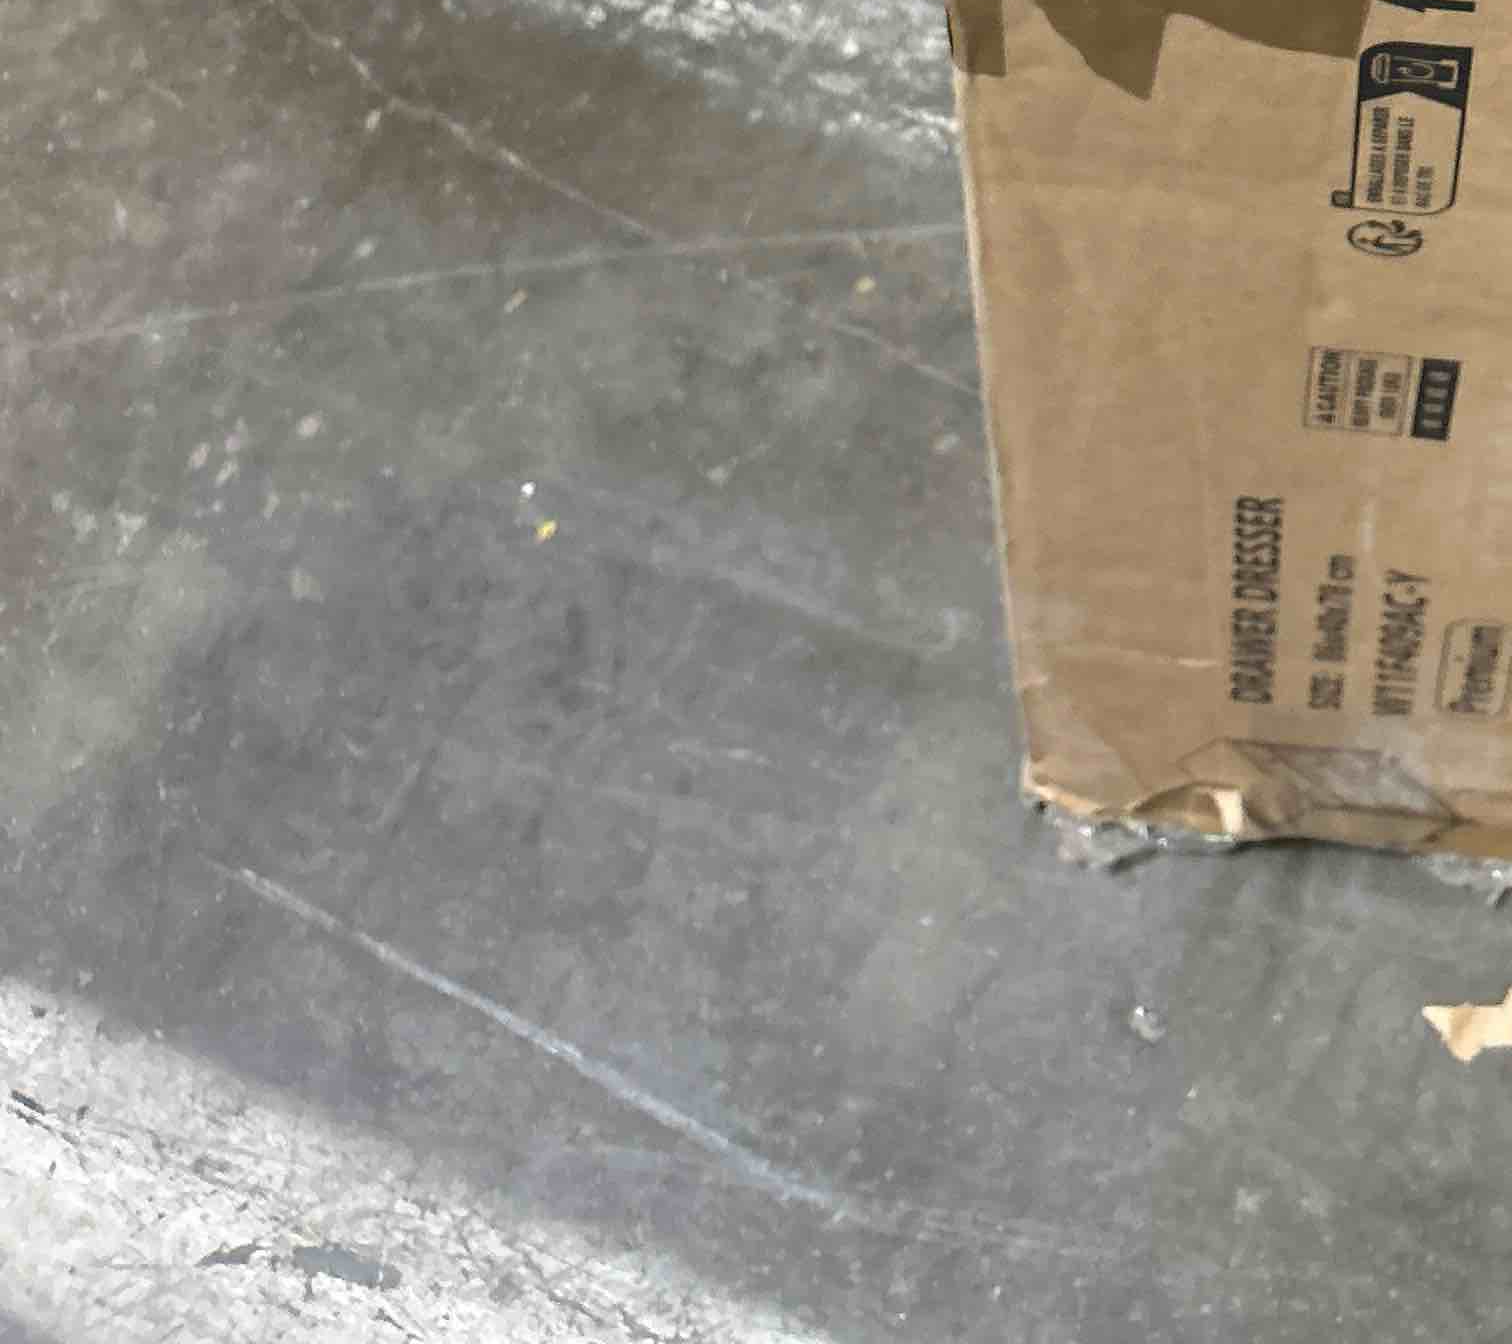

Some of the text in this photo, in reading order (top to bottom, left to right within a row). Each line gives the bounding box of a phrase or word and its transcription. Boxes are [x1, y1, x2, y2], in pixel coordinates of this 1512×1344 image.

[1229, 496, 1285, 705] DRAWER DRESSER
[1448, 624, 1503, 714] Premium
